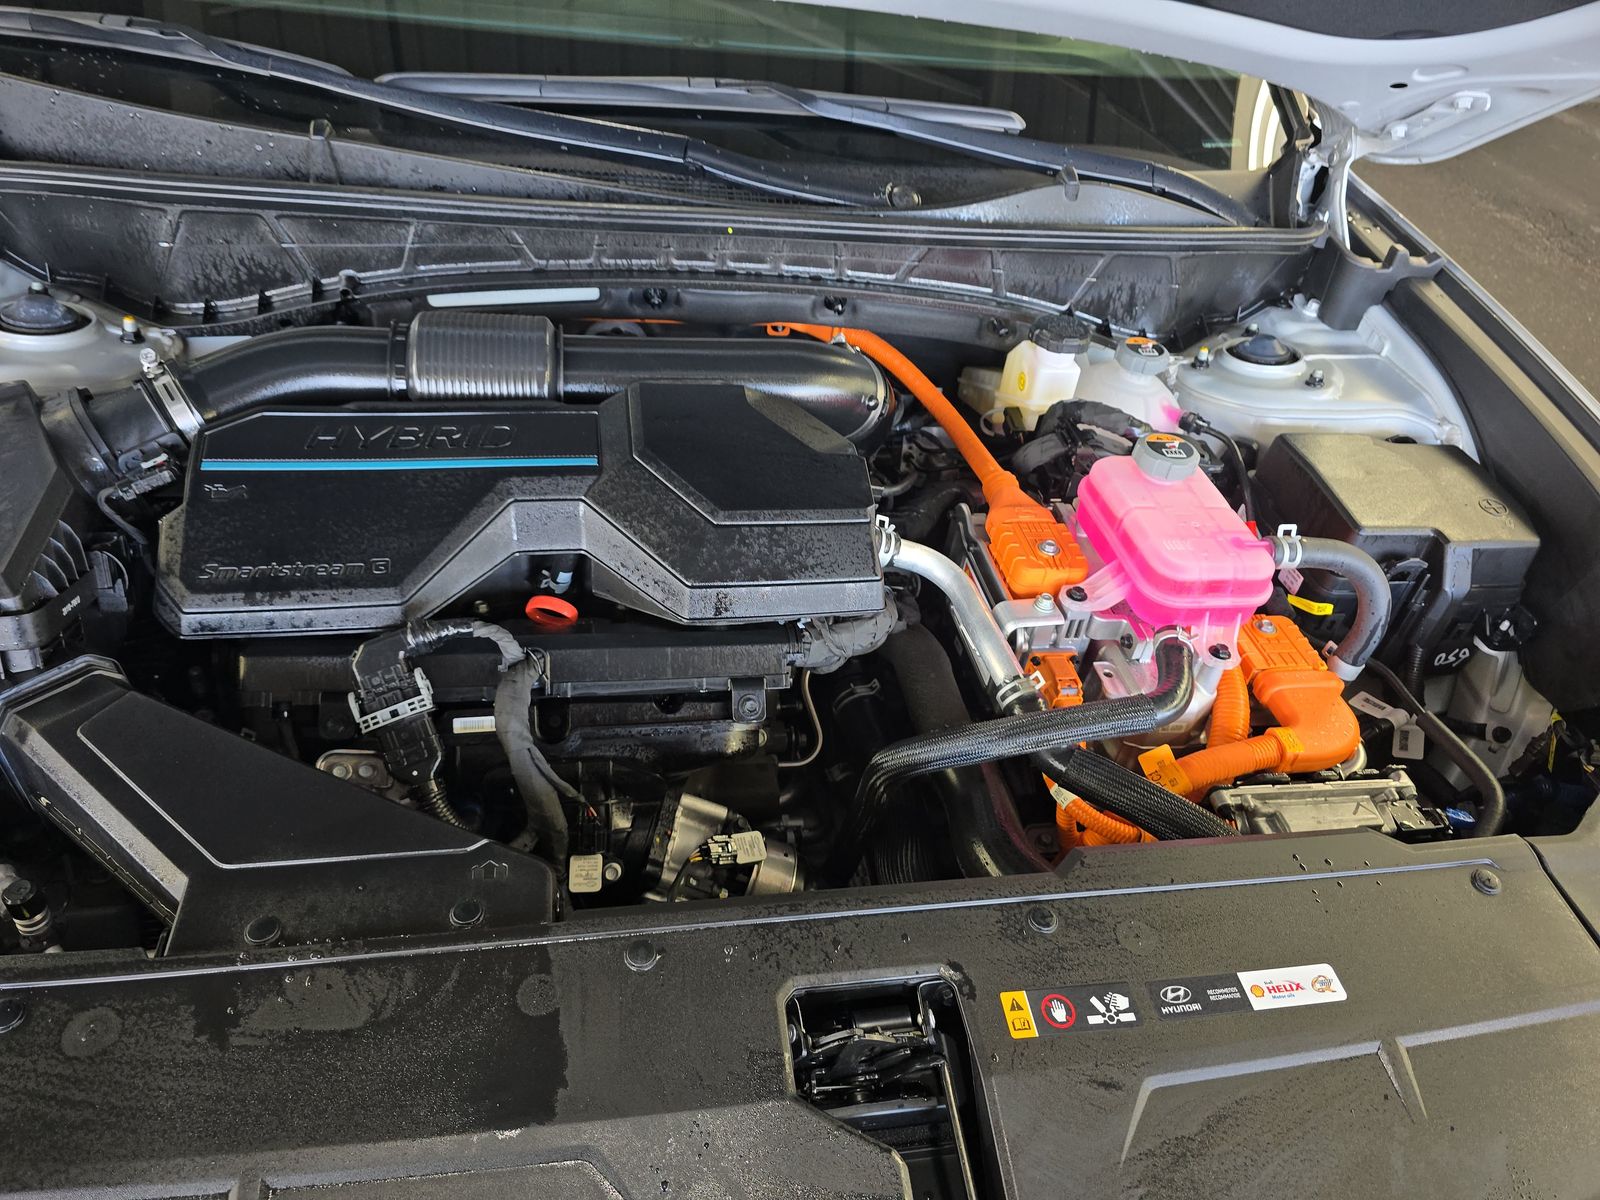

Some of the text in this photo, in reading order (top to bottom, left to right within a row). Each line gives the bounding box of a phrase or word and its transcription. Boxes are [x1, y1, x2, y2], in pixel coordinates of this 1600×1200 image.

[305, 424, 517, 449] HYBRID
[198, 557, 392, 581] Smartstream G
[1207, 987, 1238, 995] RECOMMENDS
[1266, 983, 1304, 994] HELIX
[1161, 1002, 1202, 1014] HYUNDAI
